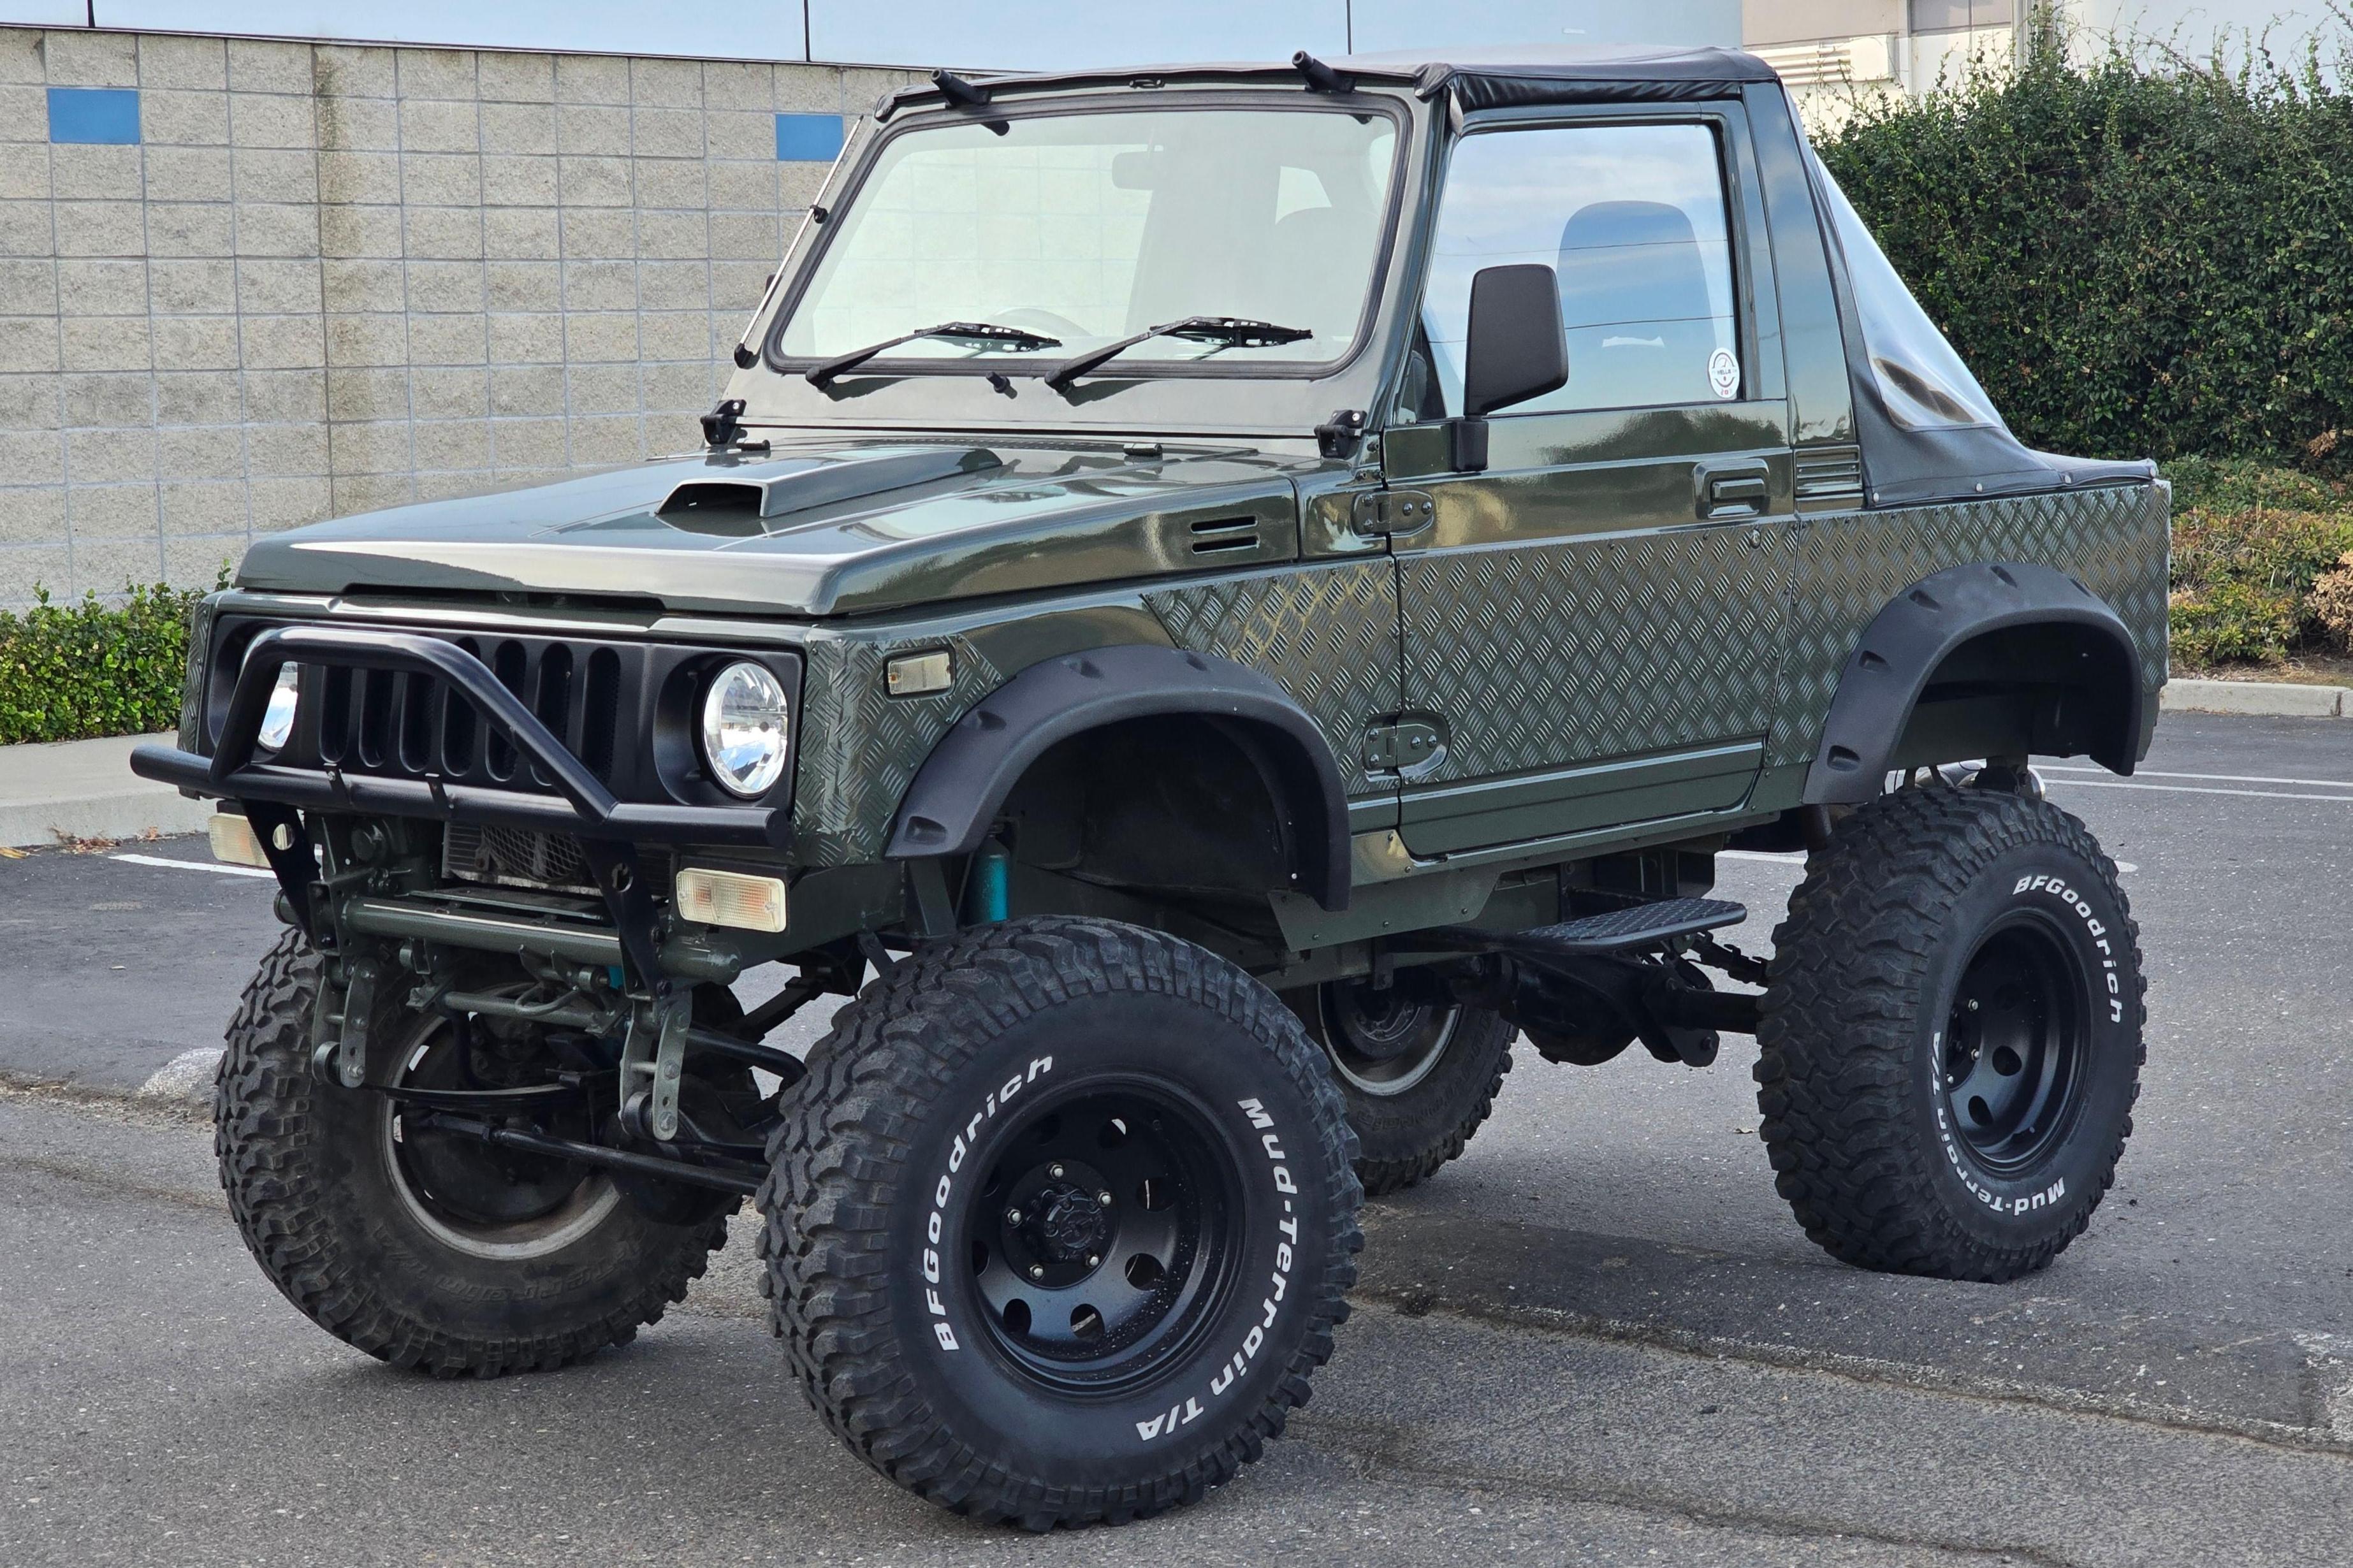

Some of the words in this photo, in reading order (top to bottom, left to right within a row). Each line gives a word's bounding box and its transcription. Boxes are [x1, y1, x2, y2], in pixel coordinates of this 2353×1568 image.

[2013, 875, 2123, 1023] BFGoodrich
[1932, 1031, 1942, 1096] T/A
[923, 1056, 1053, 1351] BFGoodrich
[1937, 1108, 2065, 1217] Mud-Terrain
[1210, 1098, 1299, 1395] Mud-Terrain
[1135, 1397, 1205, 1441] T/A
